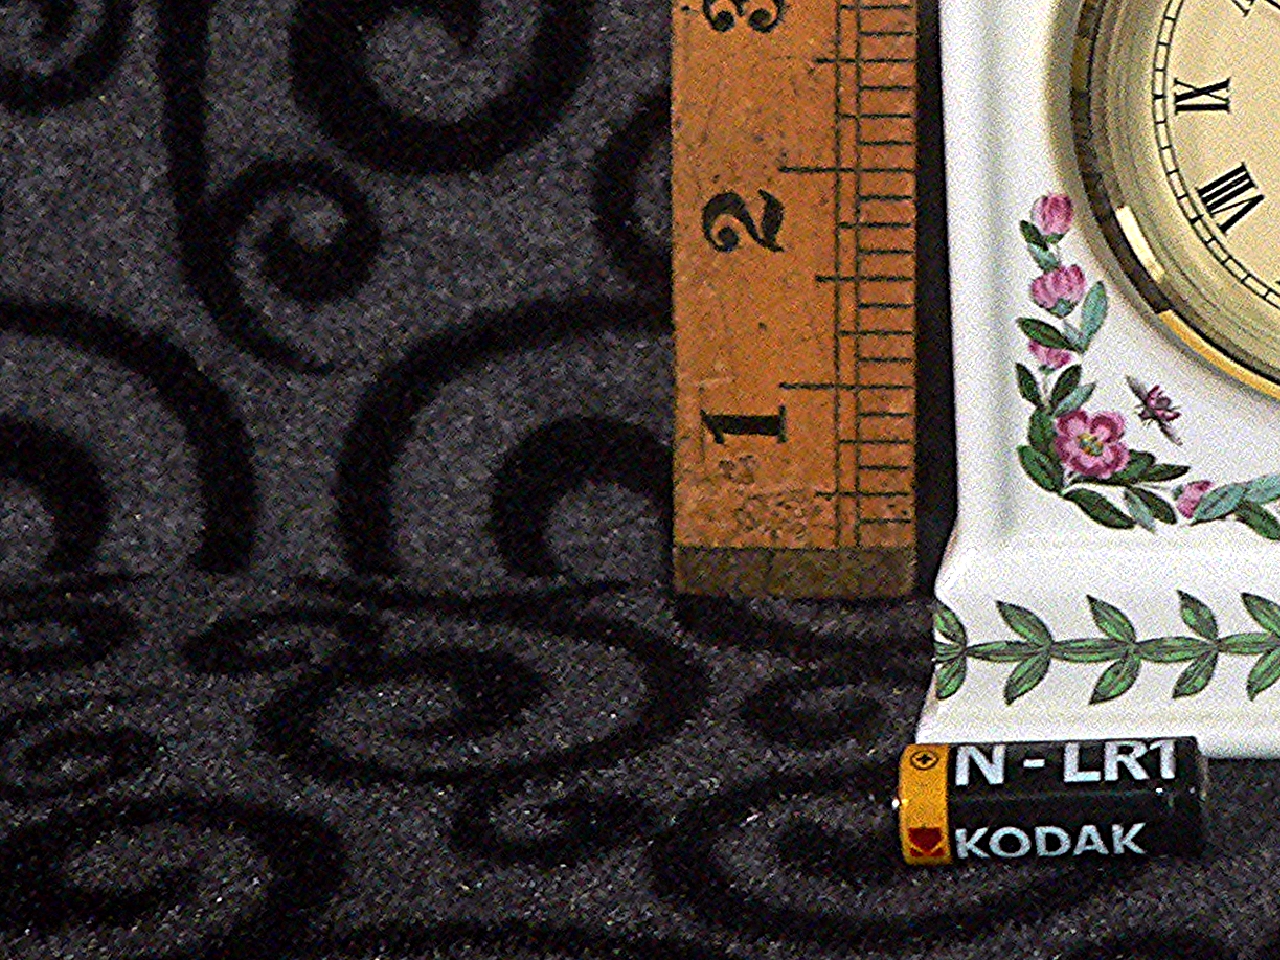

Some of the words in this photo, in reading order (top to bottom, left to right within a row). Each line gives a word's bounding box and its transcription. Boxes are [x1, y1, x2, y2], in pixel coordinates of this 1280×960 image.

[1174, 77, 1231, 115] IX
[701, 189, 784, 252] 2
[700, 404, 787, 444] 1
[955, 745, 1006, 786] N
[1063, 739, 1176, 783] LR1
[954, 822, 1148, 860] KODAK
